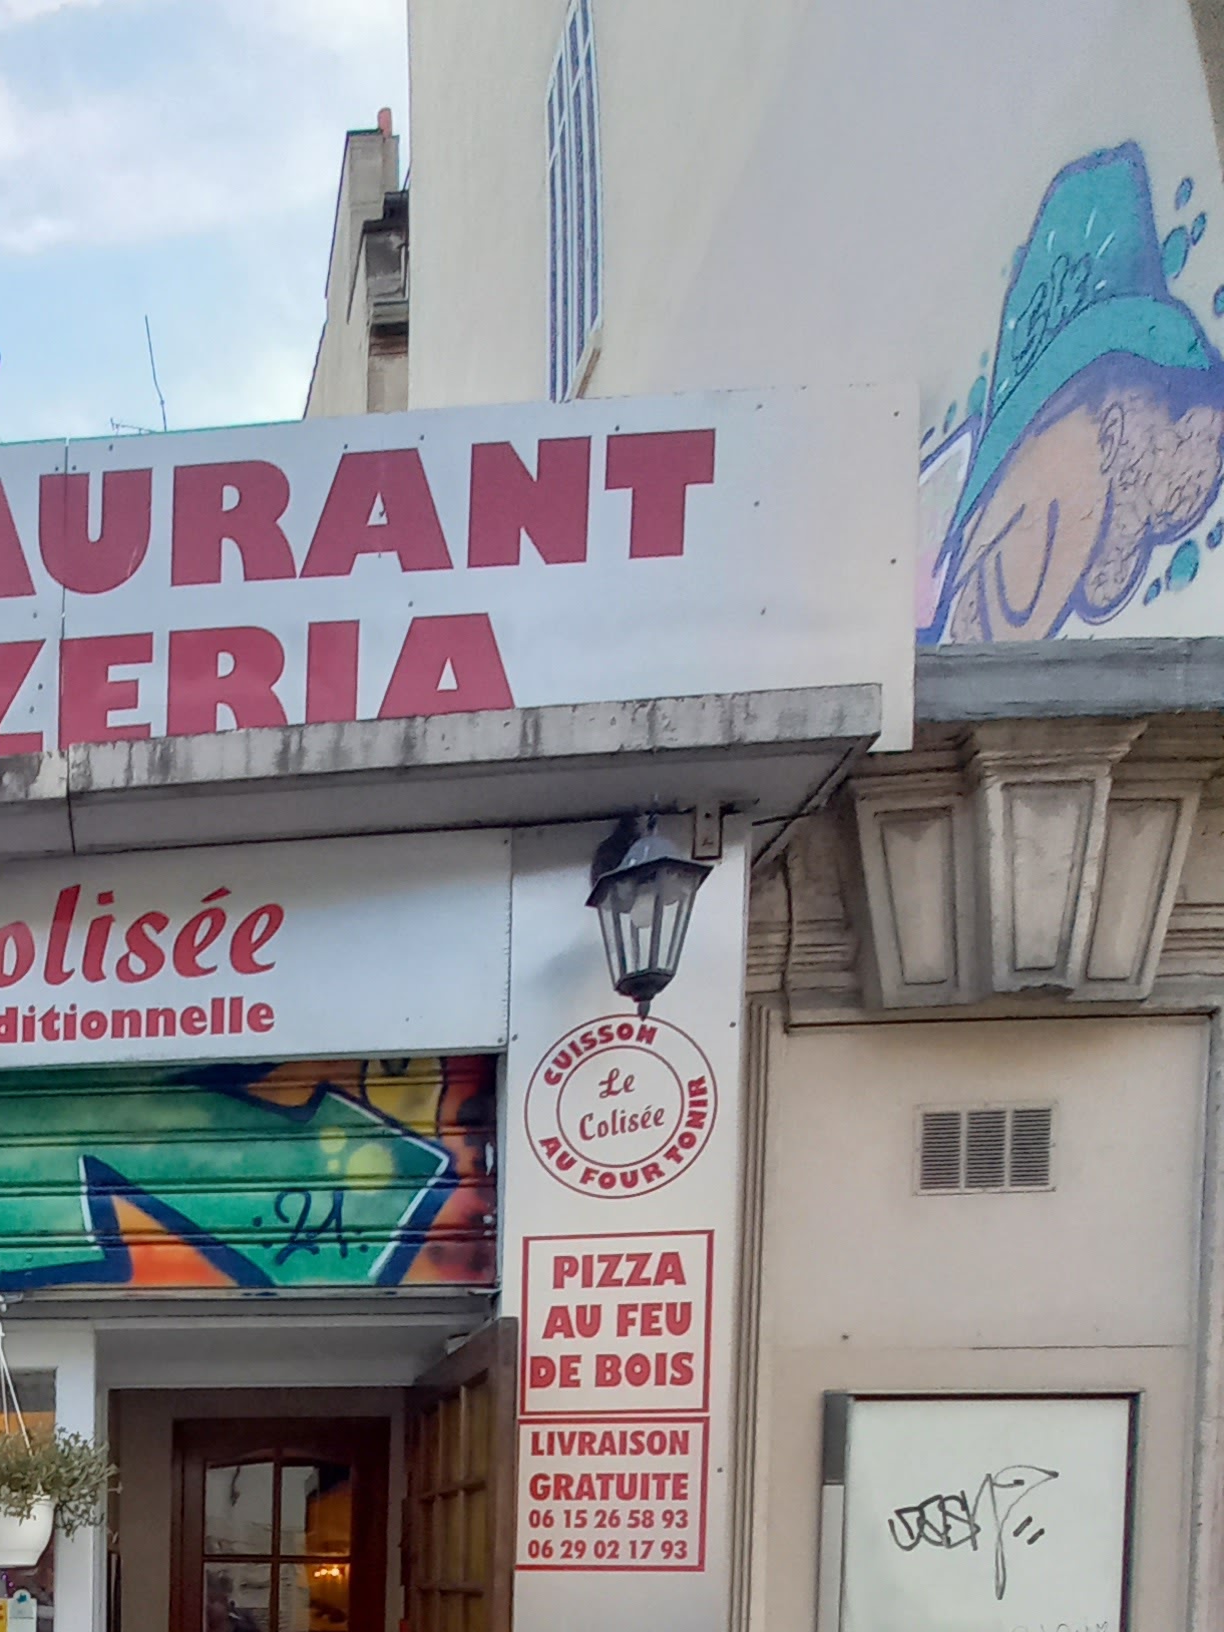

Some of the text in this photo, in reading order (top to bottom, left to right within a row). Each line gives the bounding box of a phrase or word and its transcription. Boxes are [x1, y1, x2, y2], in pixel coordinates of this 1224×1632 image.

[543, 1022, 658, 1086] CUISSON
[598, 1067, 636, 1099] Le
[538, 1075, 709, 1190] AU FOUR TONIR
[579, 1104, 665, 1141] Colisée
[552, 1251, 687, 1290] PIZZA
[541, 1301, 693, 1339] AU FEU
[529, 1351, 695, 1389] DE BOIS
[530, 1430, 690, 1457] LIVRAISON
[528, 1472, 690, 1502] GRATUITE
[528, 1509, 689, 1530] 06 15 26 58 93
[527, 1539, 688, 1560] 06 29 02 17 93
